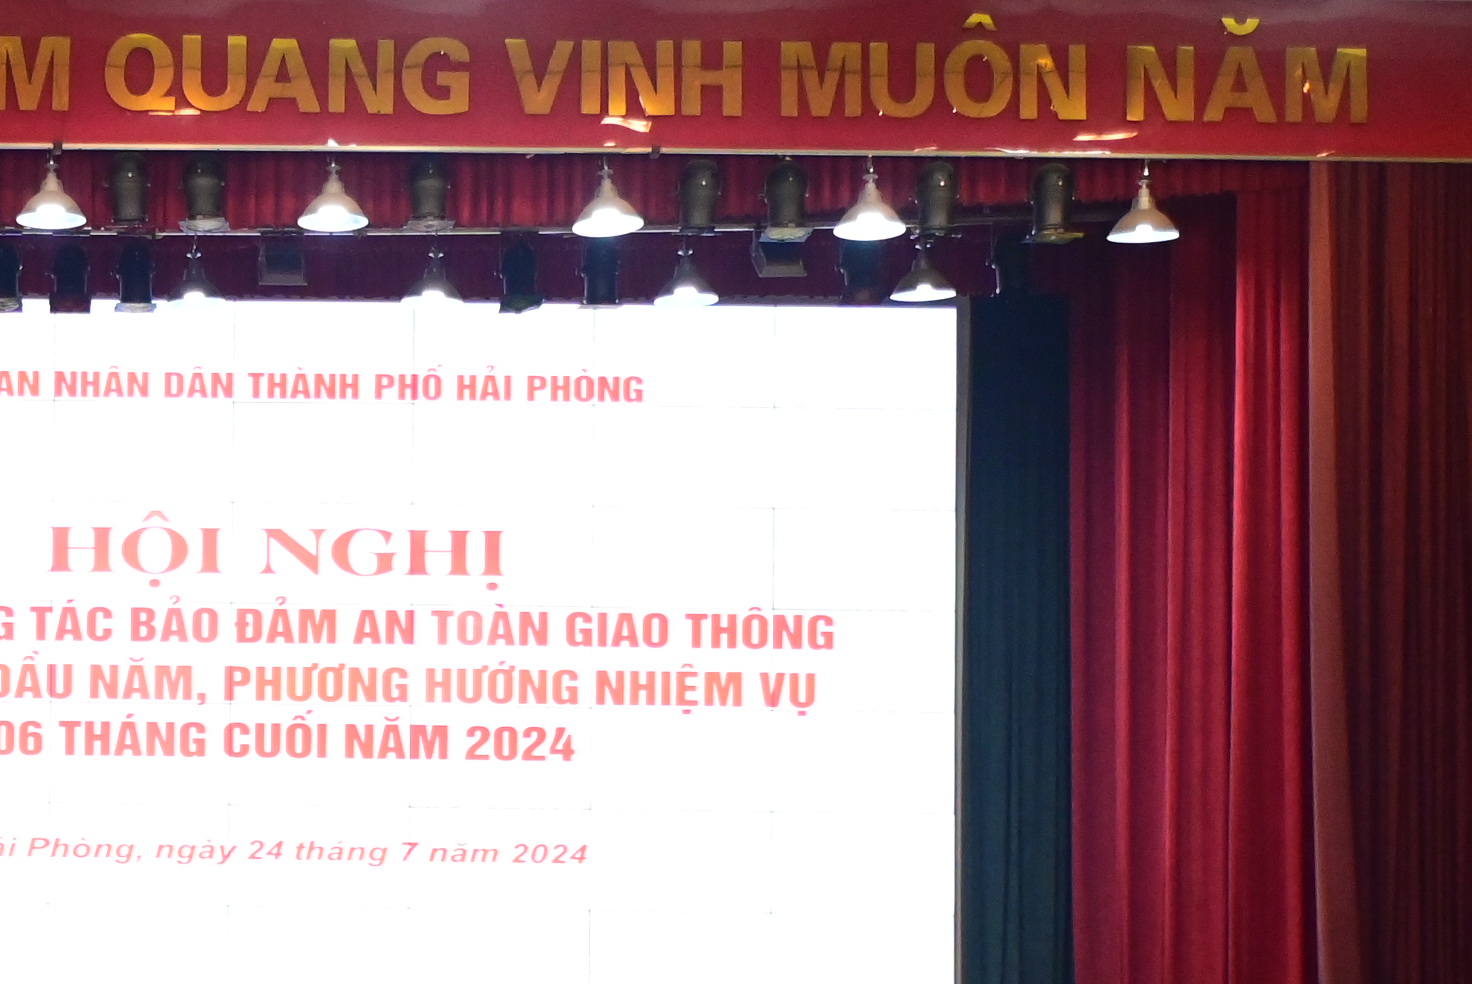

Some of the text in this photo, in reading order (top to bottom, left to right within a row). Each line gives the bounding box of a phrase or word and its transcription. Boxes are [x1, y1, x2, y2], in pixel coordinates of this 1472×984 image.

[104, 33, 470, 115] QUANG
[504, 37, 743, 117] VINH
[780, 12, 1087, 121] MUÔN
[1126, 17, 1368, 124] NĂM
[54, 366, 149, 397] NHÂN
[164, 367, 234, 398] DÂN
[248, 367, 359, 400] THÀNH
[375, 365, 442, 401] PHỐ
[457, 365, 512, 401] HẢI
[527, 369, 643, 403] PHÒNG
[49, 511, 503, 591] HỘI NGHỊ
[30, 599, 112, 642] TÁC
[131, 596, 218, 643] BẢO
[235, 596, 336, 644] ĐẢM
[353, 610, 415, 645] AN
[431, 604, 548, 646] TOÀN
[566, 612, 669, 648] GIAO
[685, 607, 834, 650] THÔNG
[90, 657, 206, 705] NĂM,
[224, 663, 408, 703] PHƯƠNG
[426, 661, 578, 705] HƯỚNG
[596, 664, 742, 714] NHIỆM
[759, 672, 816, 716] VỤ
[59, 713, 206, 757] THÁNG
[224, 710, 327, 758] CUỐI
[345, 716, 448, 759] NĂM
[465, 726, 575, 761] 2024
[28, 838, 141, 863] Phòng,
[156, 841, 237, 864] ngày
[248, 841, 283, 859] 24
[296, 841, 387, 866] tháng
[402, 842, 418, 861] 7
[430, 843, 498, 862] năm
[512, 844, 587, 863] 2024
